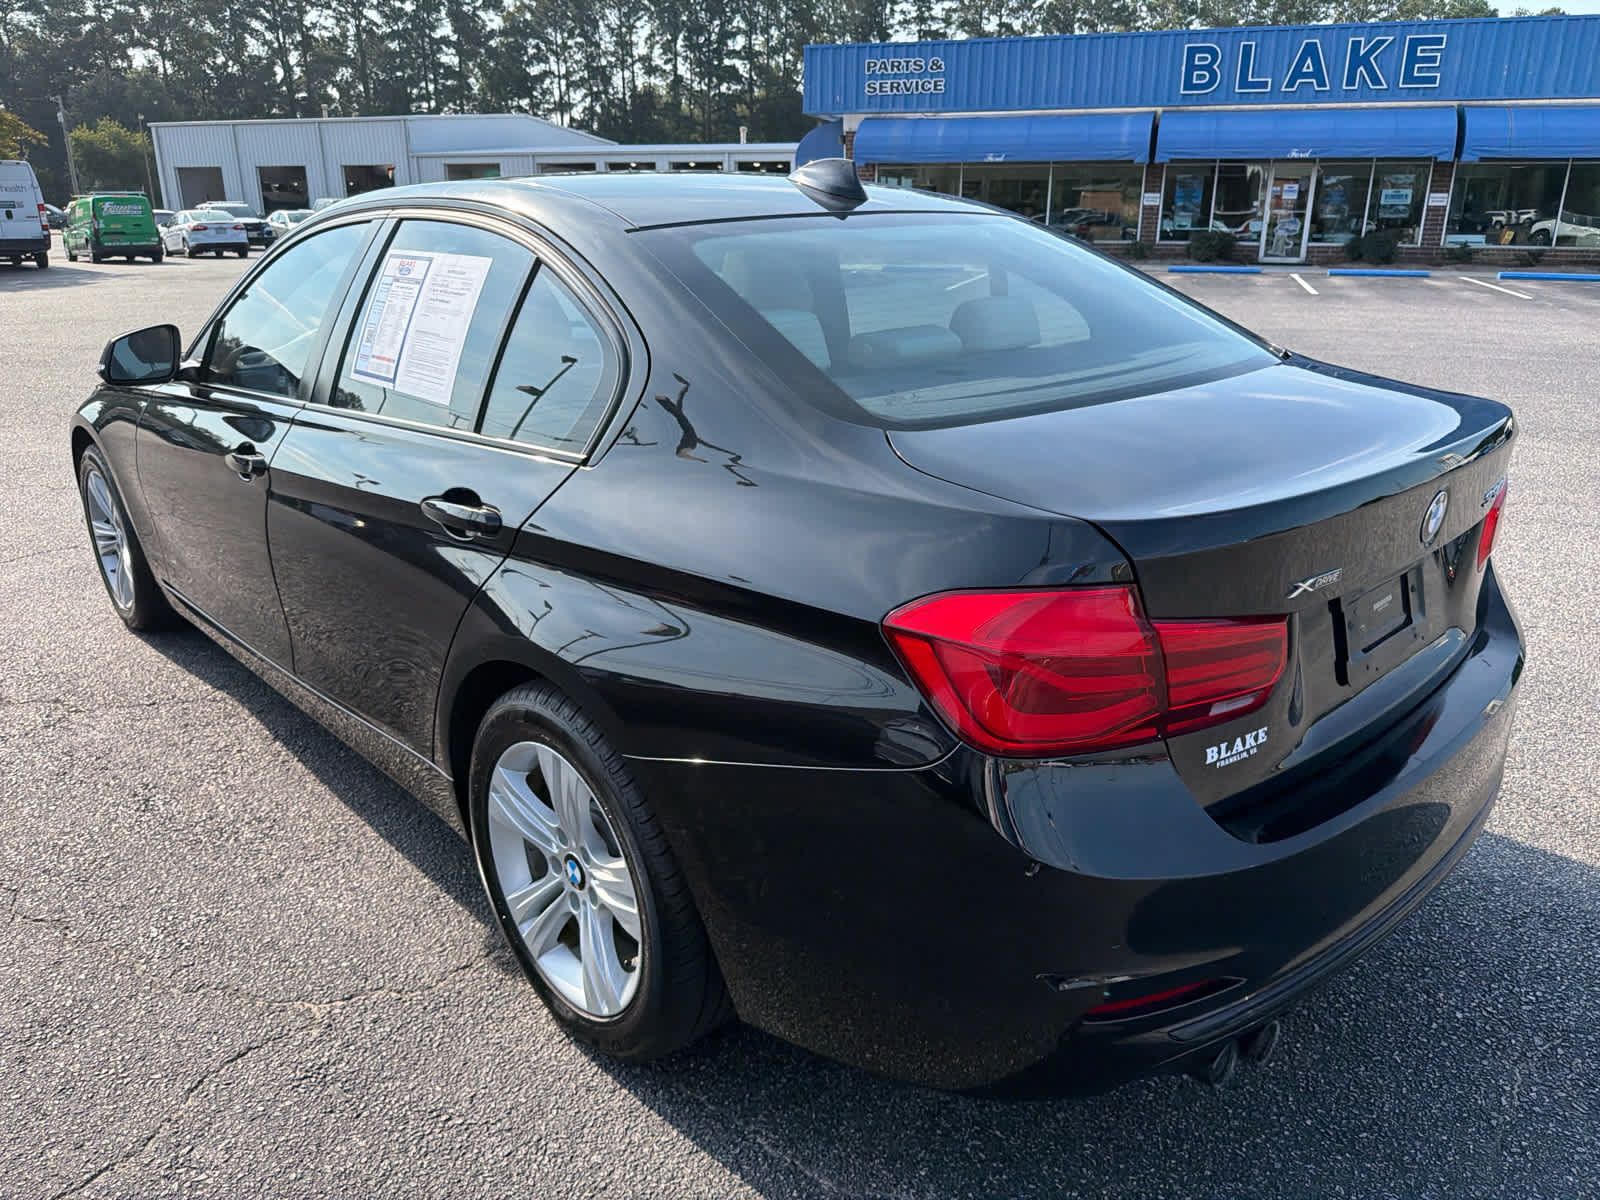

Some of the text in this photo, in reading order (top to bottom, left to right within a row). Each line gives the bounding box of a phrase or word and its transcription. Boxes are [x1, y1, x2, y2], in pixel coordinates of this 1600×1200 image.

[865, 57, 945, 74] PARTS &
[1180, 34, 1447, 95] BLAKE
[865, 78, 945, 95] SERVICE
[1205, 726, 1268, 765] BLAKE
